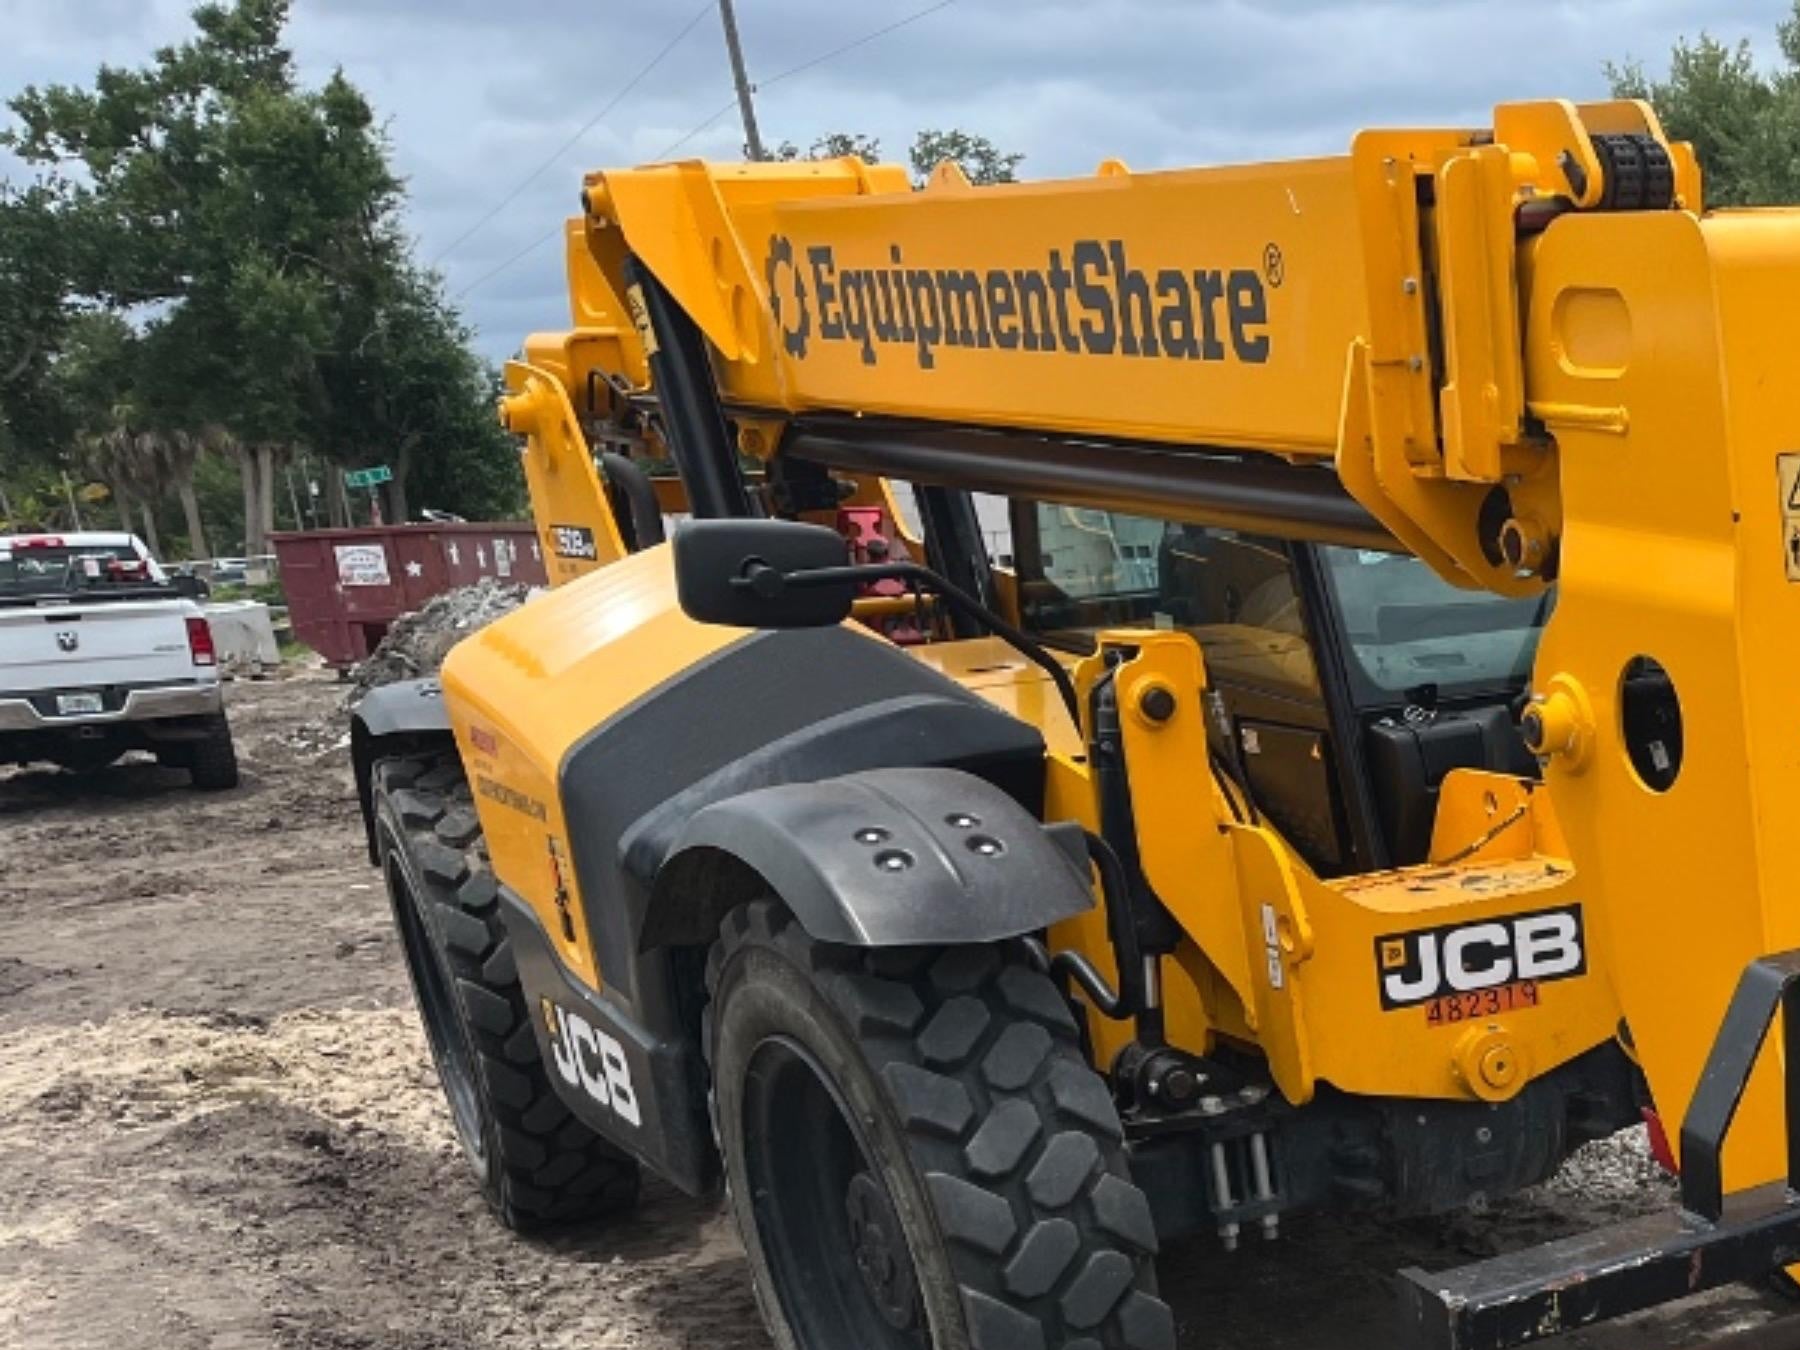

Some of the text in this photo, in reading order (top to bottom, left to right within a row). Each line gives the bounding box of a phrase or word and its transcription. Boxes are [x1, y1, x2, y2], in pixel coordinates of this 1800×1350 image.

[1385, 913, 1582, 1002] JCB
[1426, 983, 1539, 1024] 482319
[552, 1003, 642, 1127] JCB
